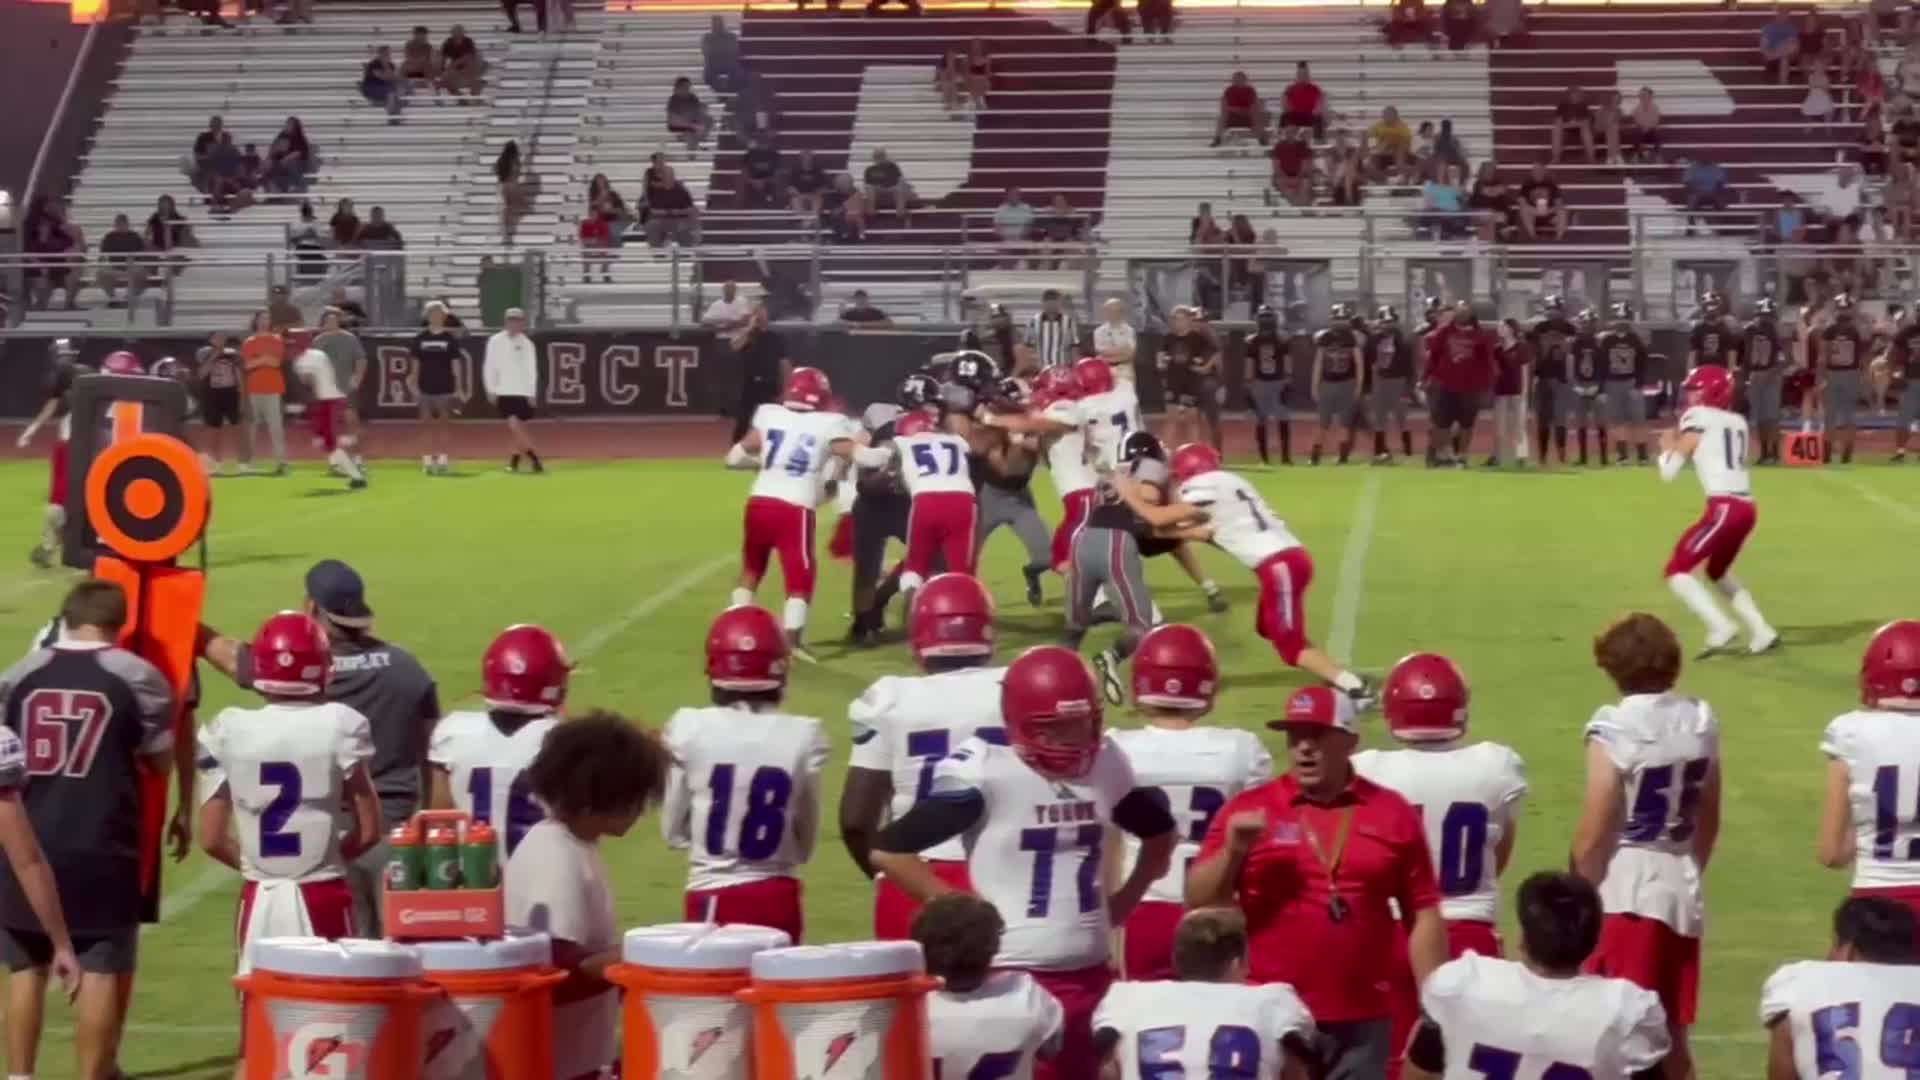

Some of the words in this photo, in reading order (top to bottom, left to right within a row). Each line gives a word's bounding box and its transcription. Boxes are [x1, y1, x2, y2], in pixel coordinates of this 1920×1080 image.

[911, 443, 960, 478] 57
[1791, 434, 1819, 462] 40
[22, 687, 113, 778] 67
[259, 761, 302, 859] 2
[707, 762, 794, 862] 18
